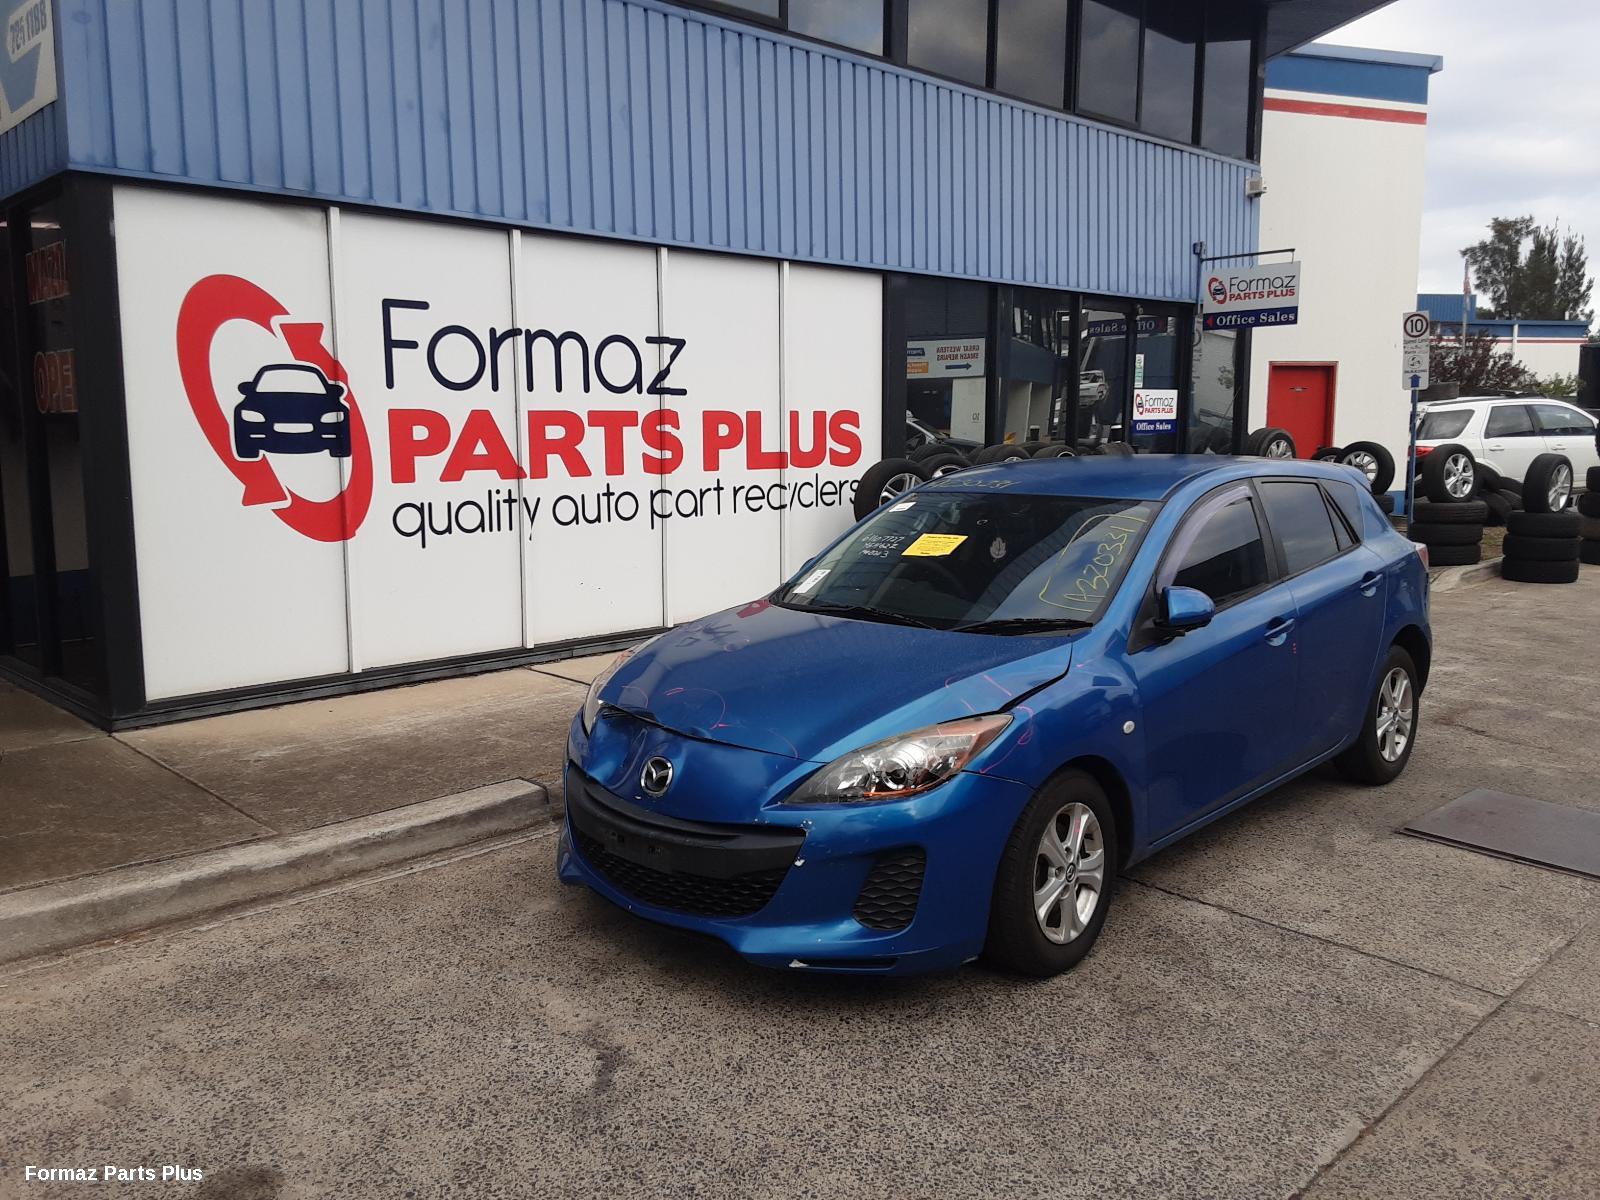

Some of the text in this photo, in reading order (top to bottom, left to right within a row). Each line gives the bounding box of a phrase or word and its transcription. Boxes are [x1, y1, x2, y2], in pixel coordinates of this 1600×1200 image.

[1229, 274, 1297, 293] Formaz
[1228, 288, 1296, 302] PARTS PLUS
[1216, 312, 1296, 327] Office Sales
[1410, 318, 1424, 333] 10
[381, 297, 688, 396] Formaz
[1144, 394, 1175, 407] Formaz
[1136, 421, 1172, 431] Office Sales
[387, 408, 863, 483] PARTS PLUS
[391, 488, 541, 549] quality
[551, 482, 640, 528] auto
[649, 478, 723, 530] part
